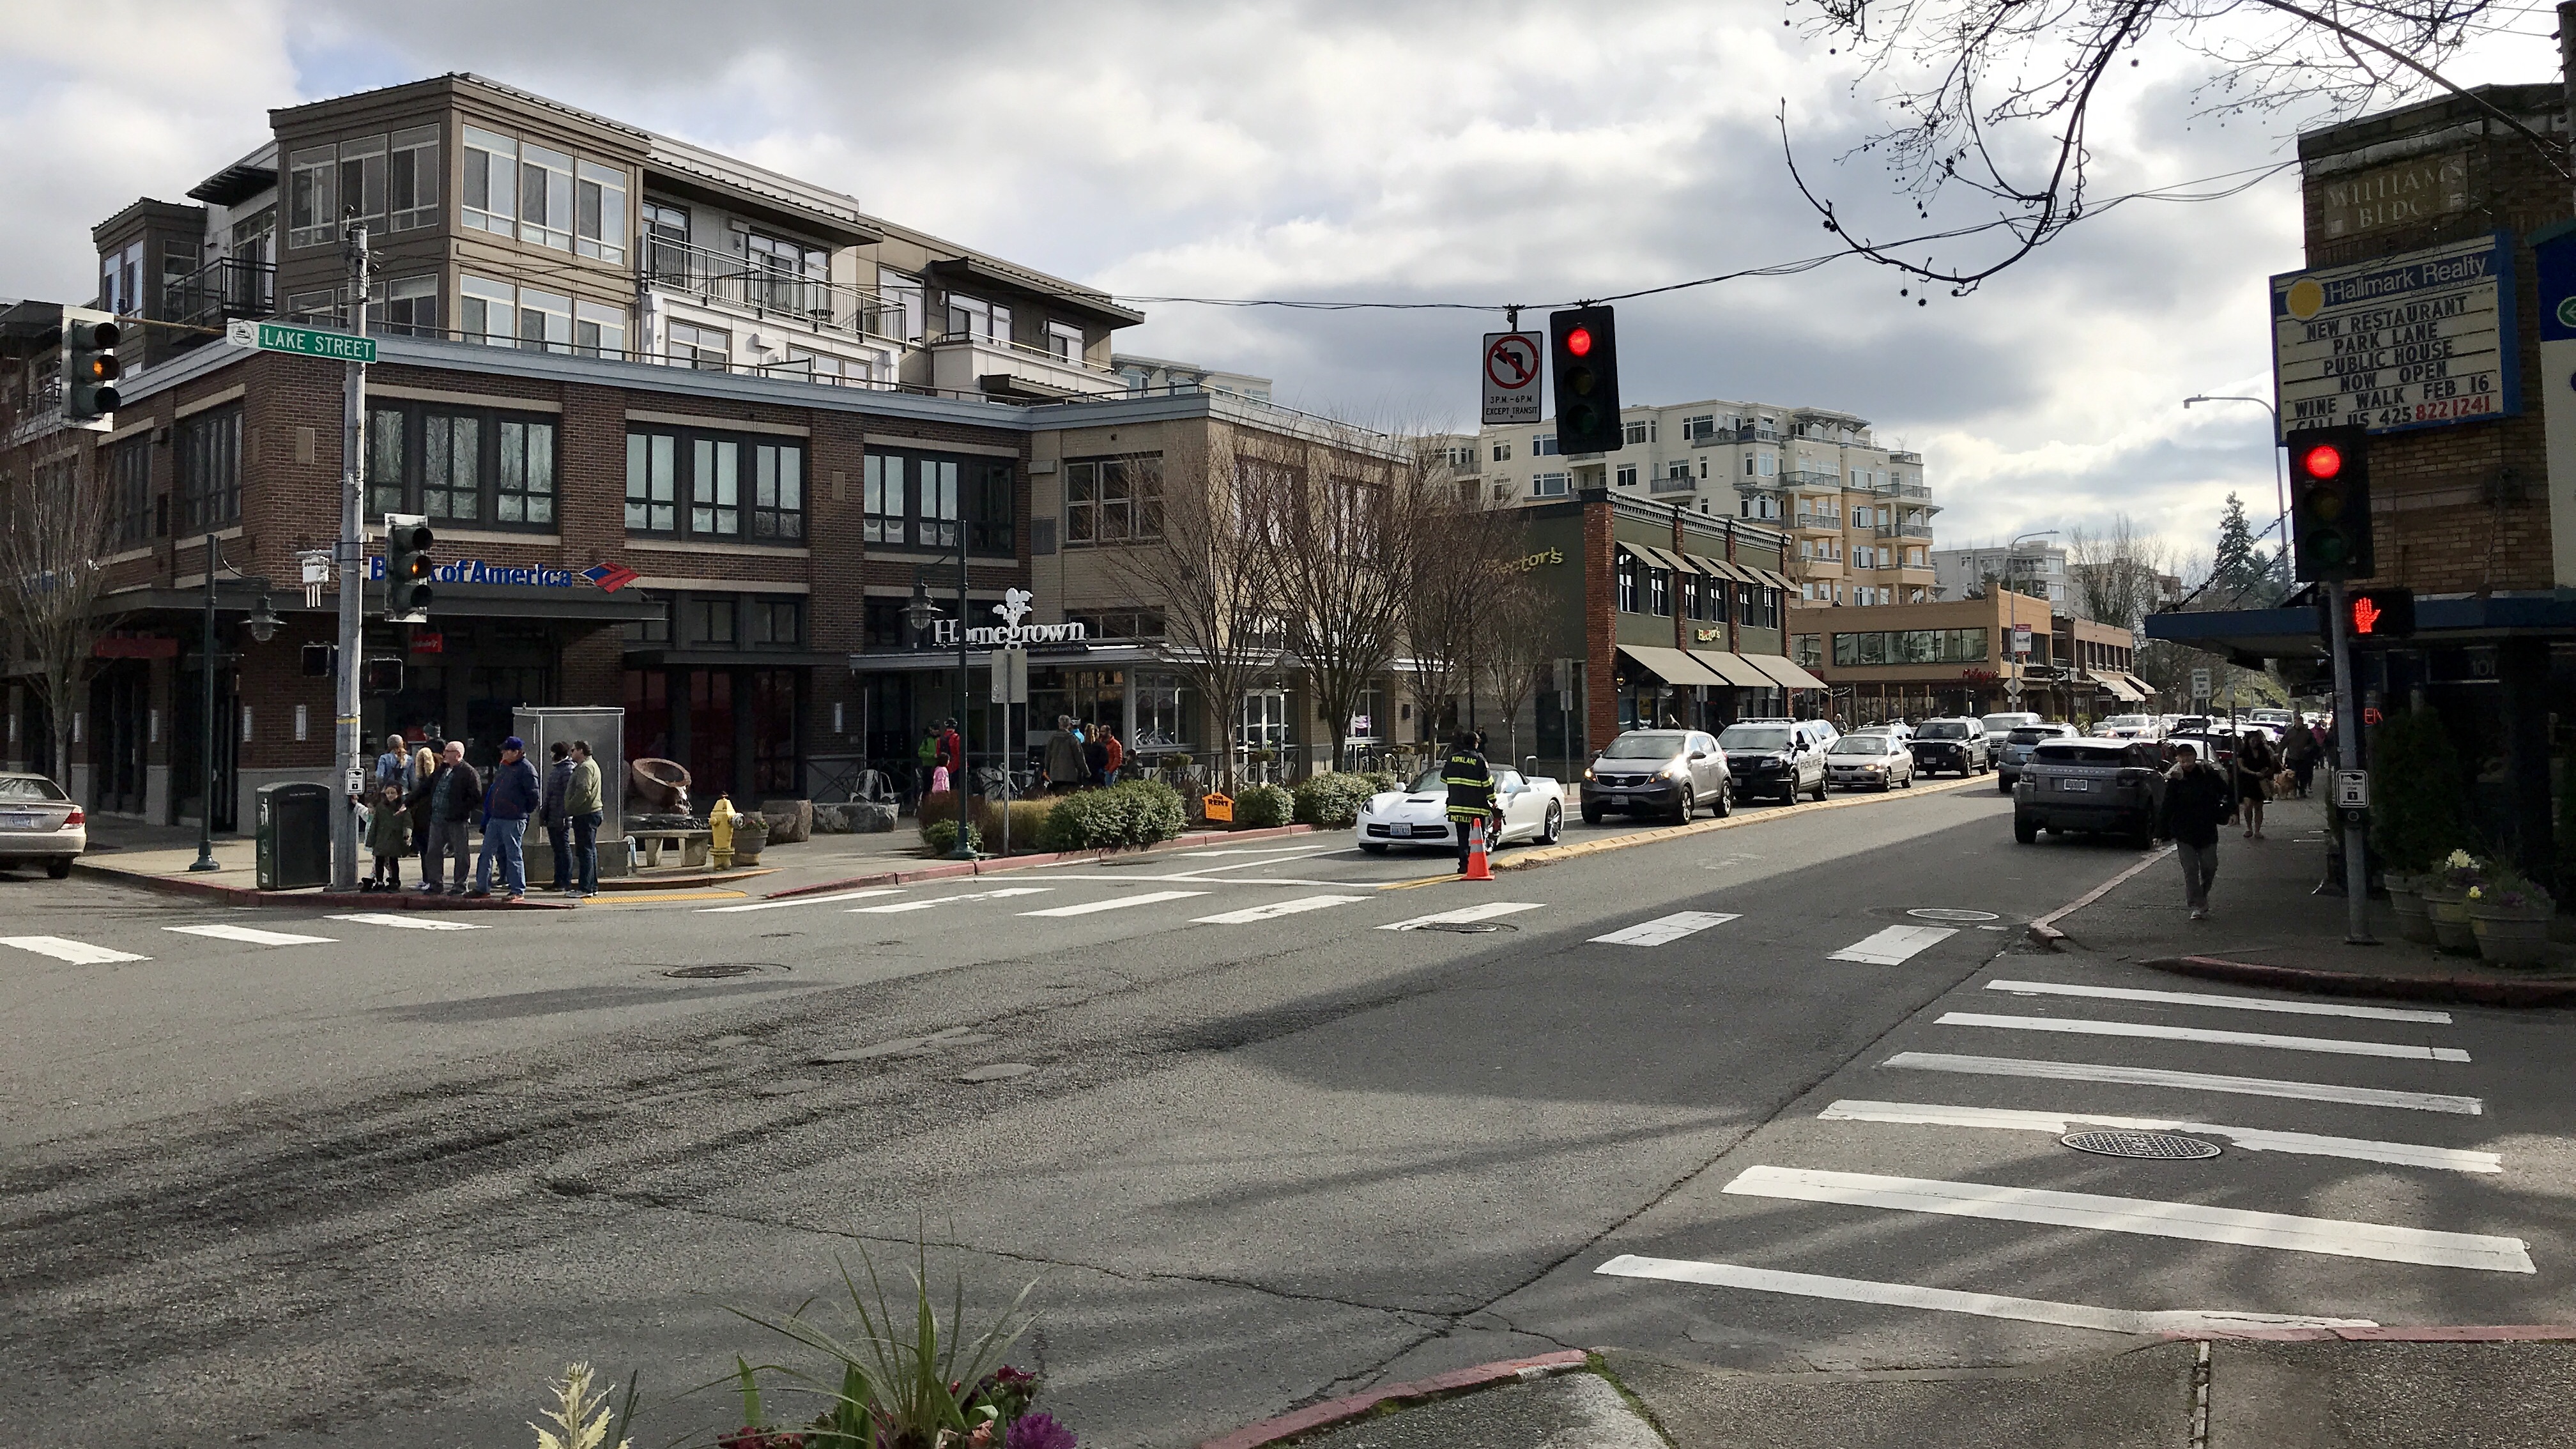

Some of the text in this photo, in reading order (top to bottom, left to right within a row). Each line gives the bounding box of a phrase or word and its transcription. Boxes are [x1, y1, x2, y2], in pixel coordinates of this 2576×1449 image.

[2330, 255, 2488, 302] Hallmark Realty
[2306, 296, 2467, 340] NEW RESTAURANT
[264, 328, 305, 350] LAKE
[315, 335, 371, 358] STREET
[2333, 321, 2437, 355] PARK LANE
[2324, 339, 2453, 376] PUBLIC HOUSE
[2340, 361, 2447, 392] NOW OPEN
[1485, 407, 1509, 415] EXCEPT
[2294, 375, 2489, 418] WINE WALK FEB 16
[2379, 406, 2412, 425] 425
[2416, 401, 2448, 421] 822
[2452, 395, 2490, 416] 1241
[439, 560, 468, 583] of
[470, 559, 573, 587] America
[933, 618, 1086, 650] Hmegrown
[2472, 660, 2496, 676] 101
[1451, 756, 1477, 765] KIRKLAND
[1800, 758, 1821, 770] POLICE
[1208, 799, 1229, 807] RENT
